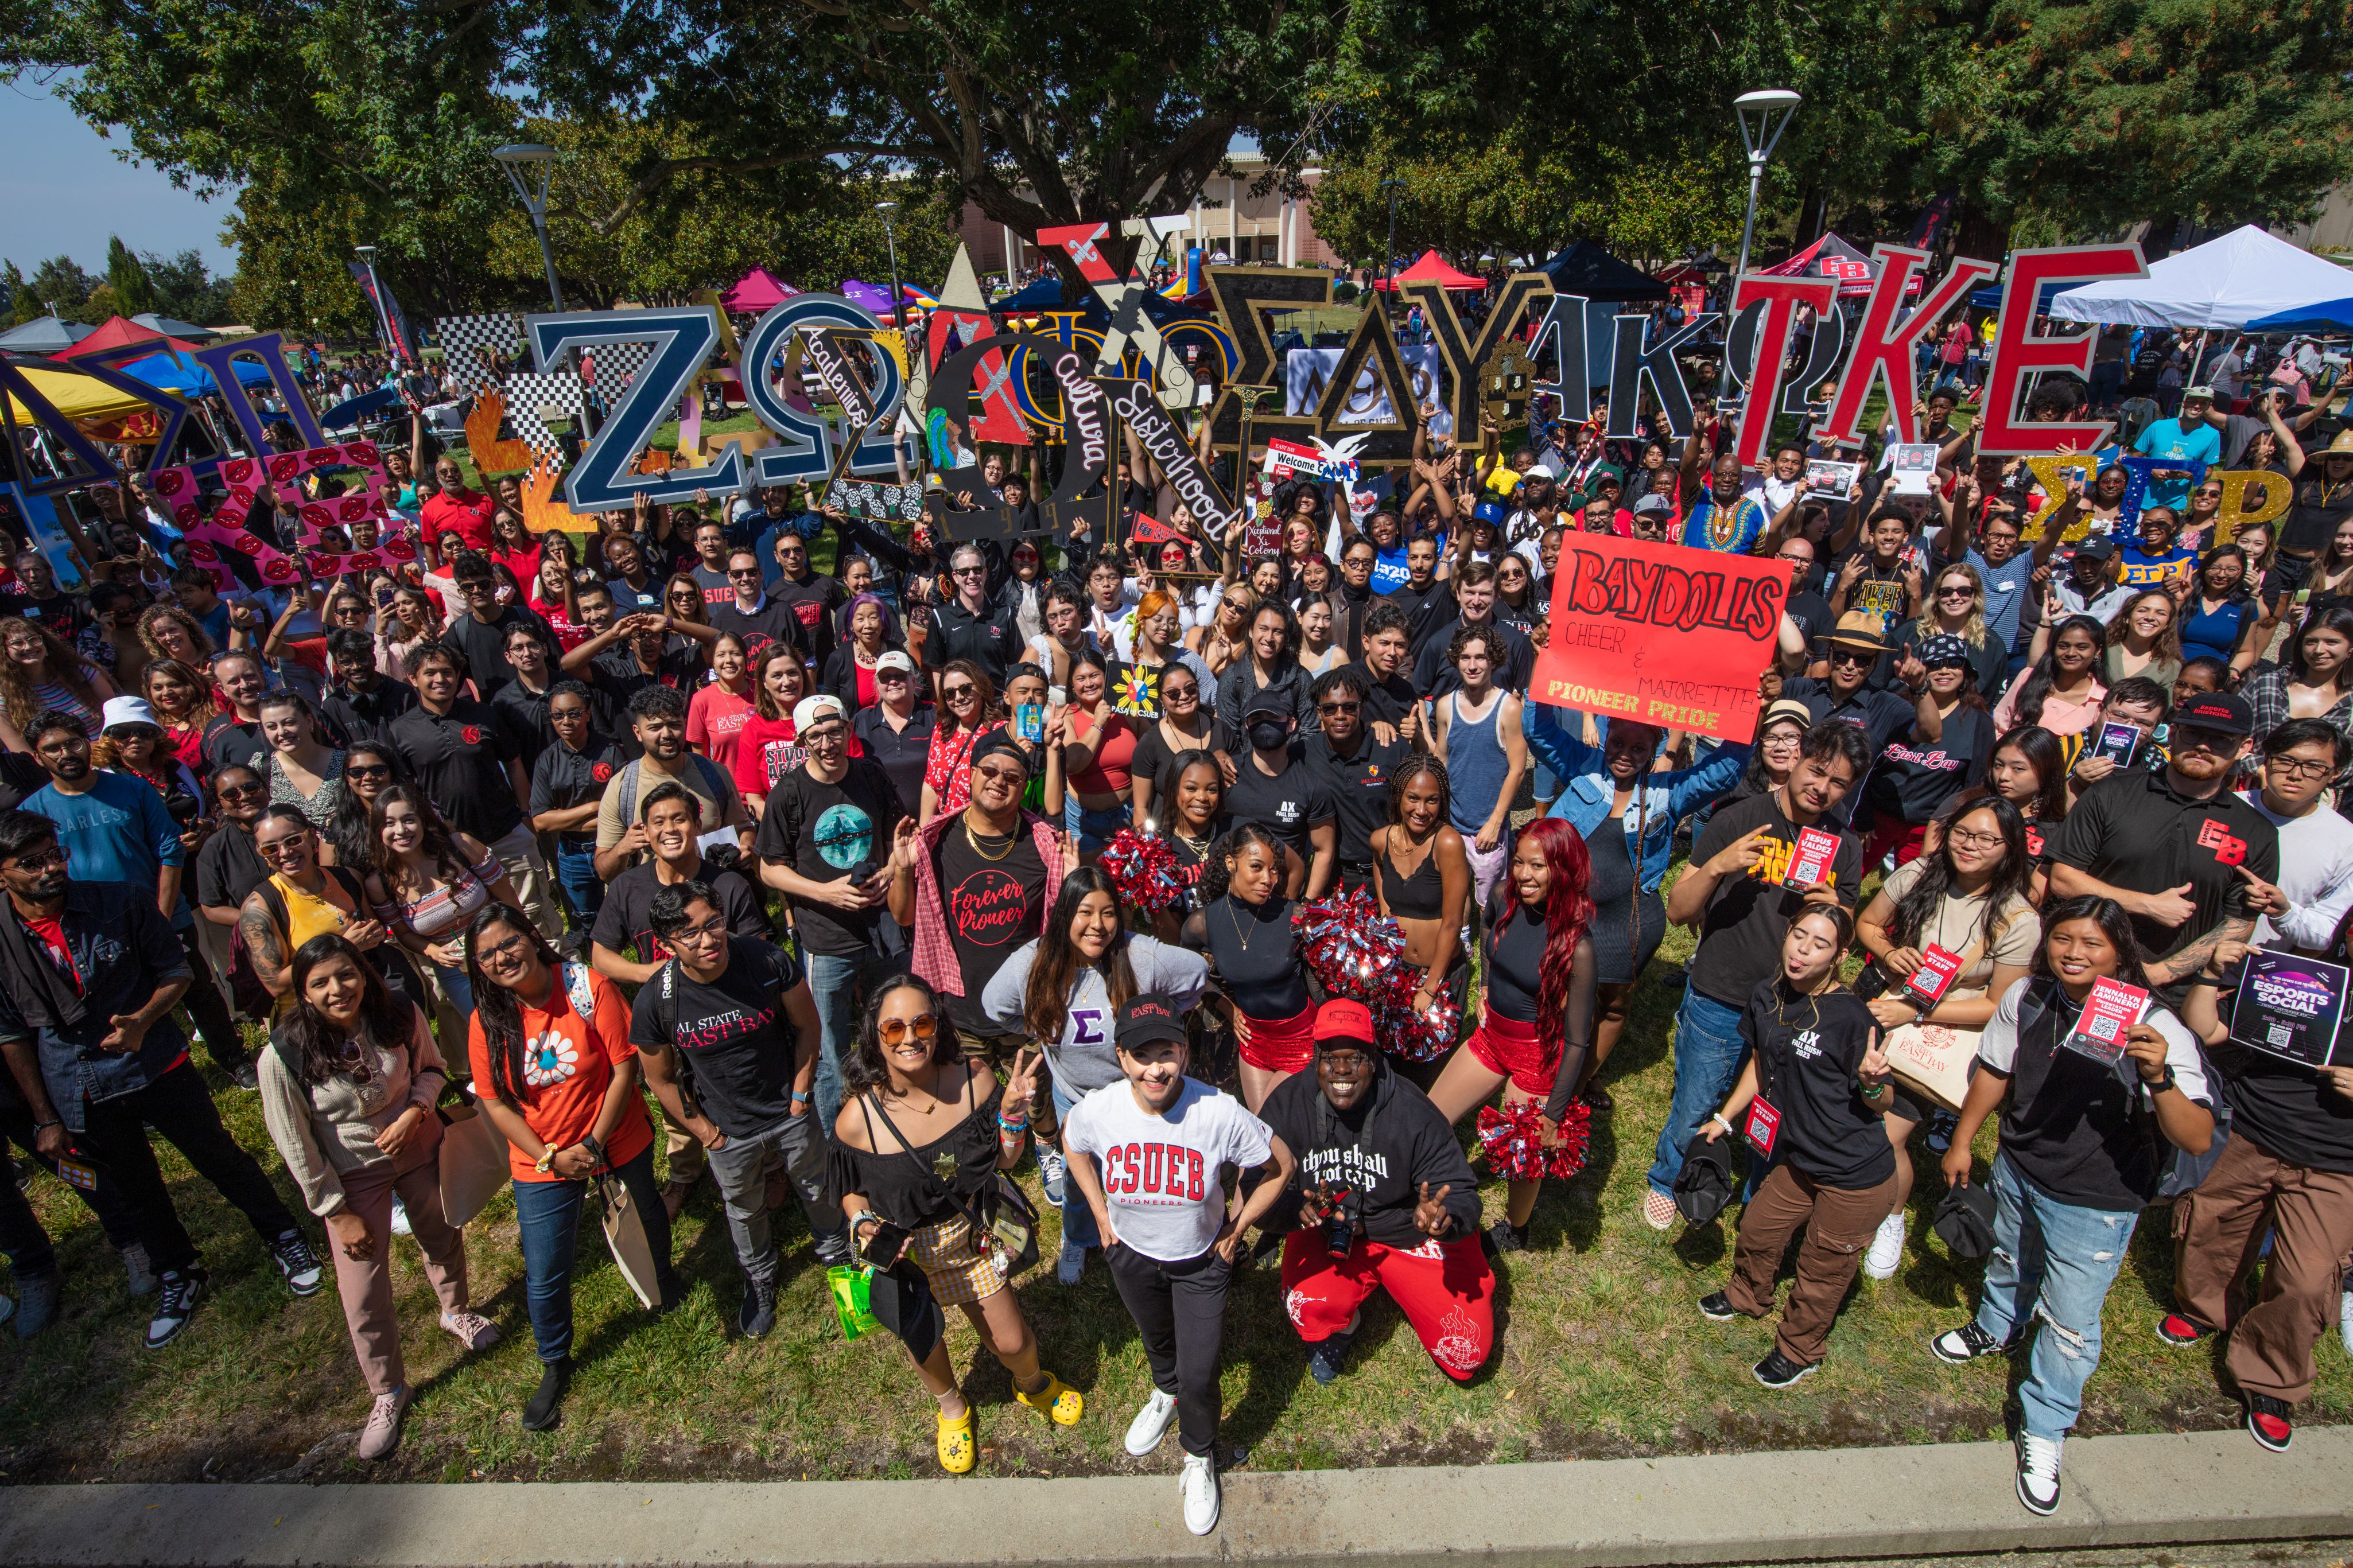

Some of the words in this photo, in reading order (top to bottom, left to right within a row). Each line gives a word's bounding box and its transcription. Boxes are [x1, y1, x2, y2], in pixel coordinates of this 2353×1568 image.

[1820, 256, 1870, 279] EB
[1838, 285, 1872, 294] PIONEERS
[798, 326, 868, 429] Academics
[1054, 352, 1106, 472] Cultura
[1275, 443, 1288, 452] EAST
[1114, 380, 1240, 542] Sisterhood
[1278, 452, 1315, 472] Welcome
[1137, 522, 1153, 537] EB
[1153, 525, 1165, 540] CAL
[1248, 524, 1282, 536] Xceptional
[1248, 544, 1280, 556] Colony
[1257, 536, 1271, 546] Xi
[702, 586, 736, 604] SUE
[1568, 548, 1783, 642] BAYDOLLS
[794, 603, 821, 615] OREVER
[1789, 613, 1807, 623] HEIR
[991, 625, 1000, 635] EB
[1565, 621, 1626, 653] CHEER
[1547, 679, 1639, 714] PIONEER
[1648, 699, 1721, 731] PRIDE
[1637, 677, 1759, 715] MAJORETTE
[1111, 705, 1129, 715] PASA
[1130, 707, 1137, 716] of
[1137, 709, 1159, 719] CSUEB
[2193, 709, 2233, 719] Illustrated
[2200, 705, 2230, 714] Esports
[210, 722, 228, 736] Columbia
[764, 742, 778, 750] CAL
[2105, 735, 2130, 744] ESPORTS
[2105, 740, 2126, 748] SOCIAL
[766, 746, 811, 764] STUDE
[1884, 742, 1925, 764] East
[1921, 750, 1959, 772] Bay
[1805, 832, 1832, 847] JESUS
[2200, 821, 2213, 844] ESPORTS
[1800, 839, 1833, 855] VALDEZ
[2196, 818, 2248, 867] EB
[1804, 852, 1822, 860] LEADER
[950, 883, 1024, 915] Forever
[959, 907, 1024, 936] Pioneer
[1927, 950, 1957, 970] VOLUNTEER
[1927, 956, 1950, 972] STAFF
[2092, 990, 2140, 1009] LAMINERO
[2096, 985, 2141, 1003] JENNALYN
[2253, 980, 2329, 1006] ESPORTS
[2095, 998, 2131, 1013] ORIENTATION
[2100, 1005, 2123, 1014] LEADER
[2257, 991, 2319, 1015] SOCIAL
[2277, 1007, 2298, 1015] SEPTEMBER
[677, 1022, 694, 1033] AL
[698, 1009, 742, 1031] STATE
[1131, 1007, 1154, 1019] EAST
[1156, 1007, 1171, 1018] BAY
[2094, 1007, 2127, 1020] SHE/HER/HERS
[2262, 1014, 2276, 1024] 2:00
[2281, 1020, 2296, 1028] 5:30
[677, 1022, 733, 1048] EAST
[737, 1005, 774, 1034] BAY
[1791, 1038, 1805, 1050] FALL
[1804, 1044, 1823, 1057] RUSH
[1795, 1048, 1811, 1060] 2023
[1903, 1037, 1915, 1046] CAL
[1915, 1043, 1935, 1057] STATE
[2087, 1040, 2104, 1050] EAST
[2105, 1045, 2118, 1053] BAY
[1898, 1041, 1927, 1062] EAST
[1927, 1055, 1950, 1073] BAY
[1754, 1101, 1777, 1122] VOLUNTEER
[1755, 1107, 1773, 1124] STAFF
[1303, 1147, 1341, 1174] thou
[1343, 1143, 1389, 1179] shall
[1105, 1142, 1206, 1203] CSUEB
[1120, 1197, 1183, 1207] PIONEERS
